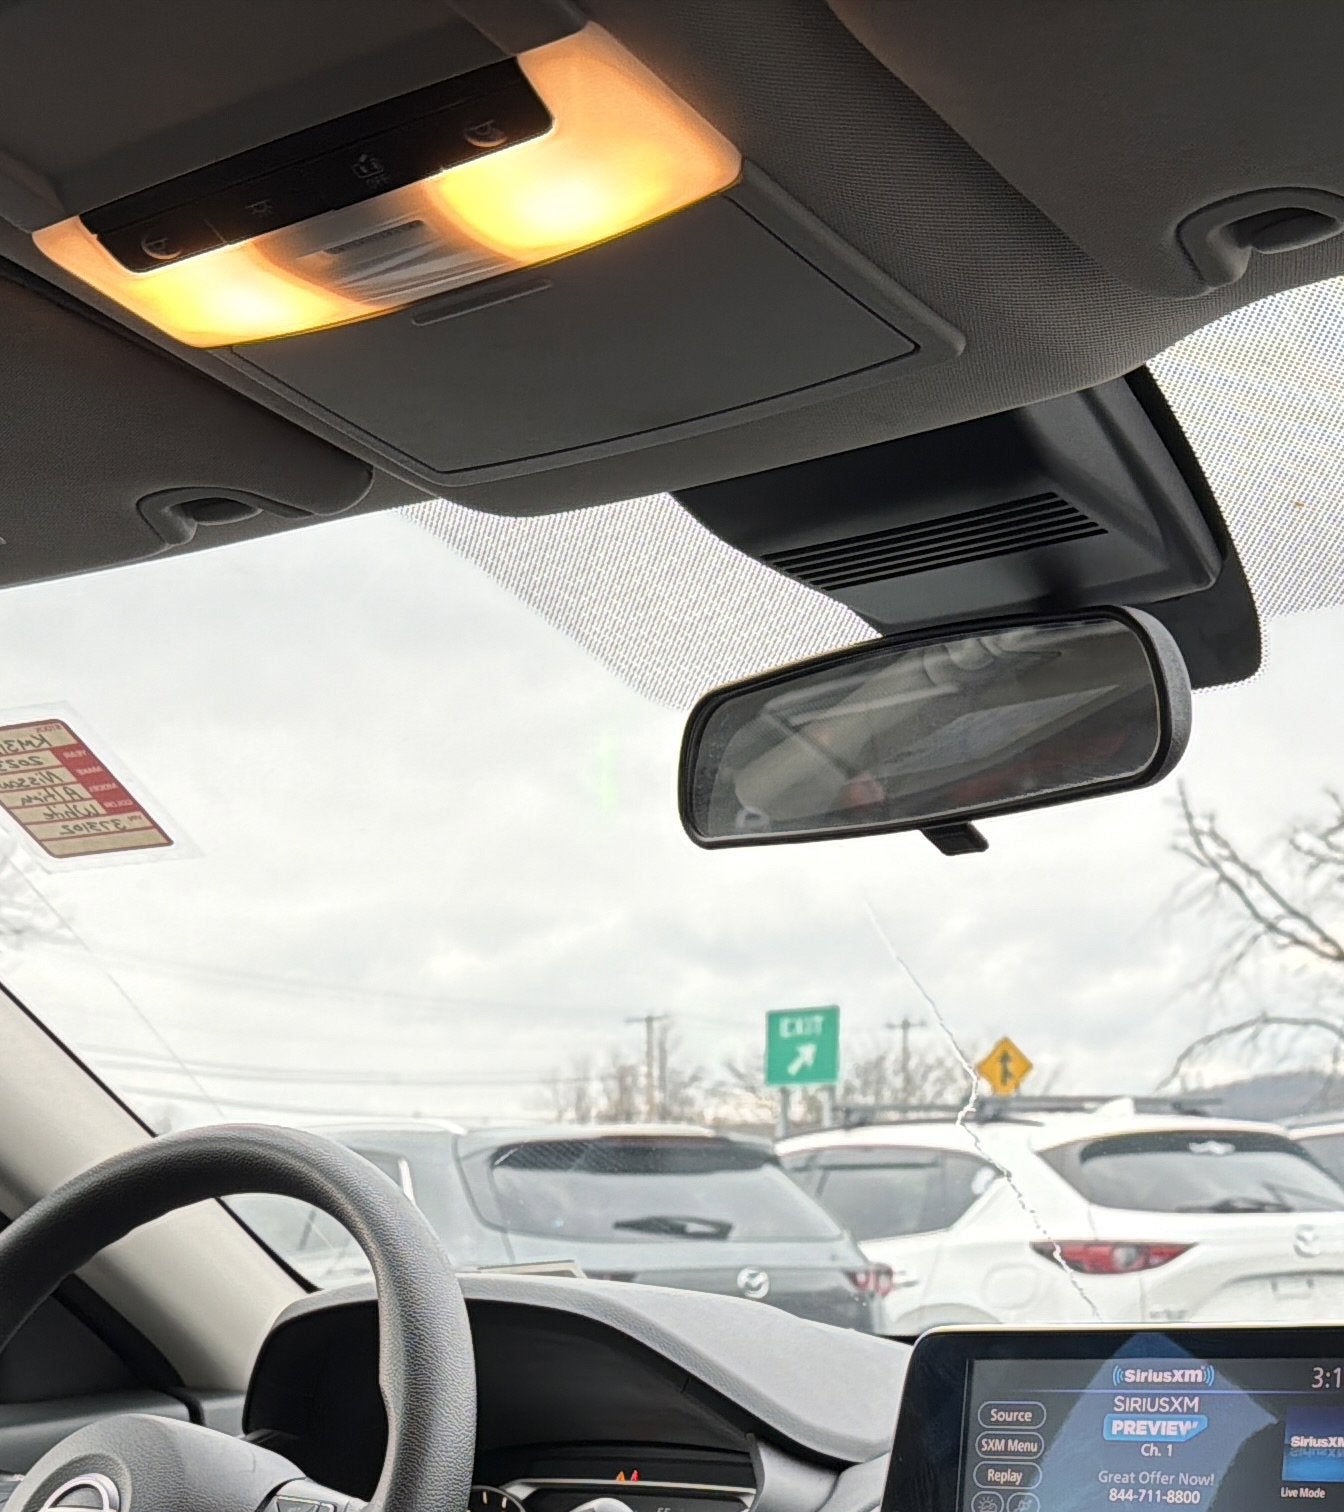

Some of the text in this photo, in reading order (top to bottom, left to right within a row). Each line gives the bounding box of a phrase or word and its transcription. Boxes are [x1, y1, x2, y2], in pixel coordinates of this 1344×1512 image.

[1113, 1396, 1200, 1413] SIRIUSXM
[990, 1408, 1033, 1422] Source
[1111, 1419, 1200, 1436] PREVIEW
[981, 1438, 1038, 1453] SXM Menu
[1140, 1443, 1173, 1457] Ch. 1
[987, 1468, 1023, 1486] Replay
[1098, 1470, 1215, 1487] Great Offer Now!
[1108, 1489, 1201, 1504] 844-711-8800
[1280, 1487, 1326, 1498] Live Mode
